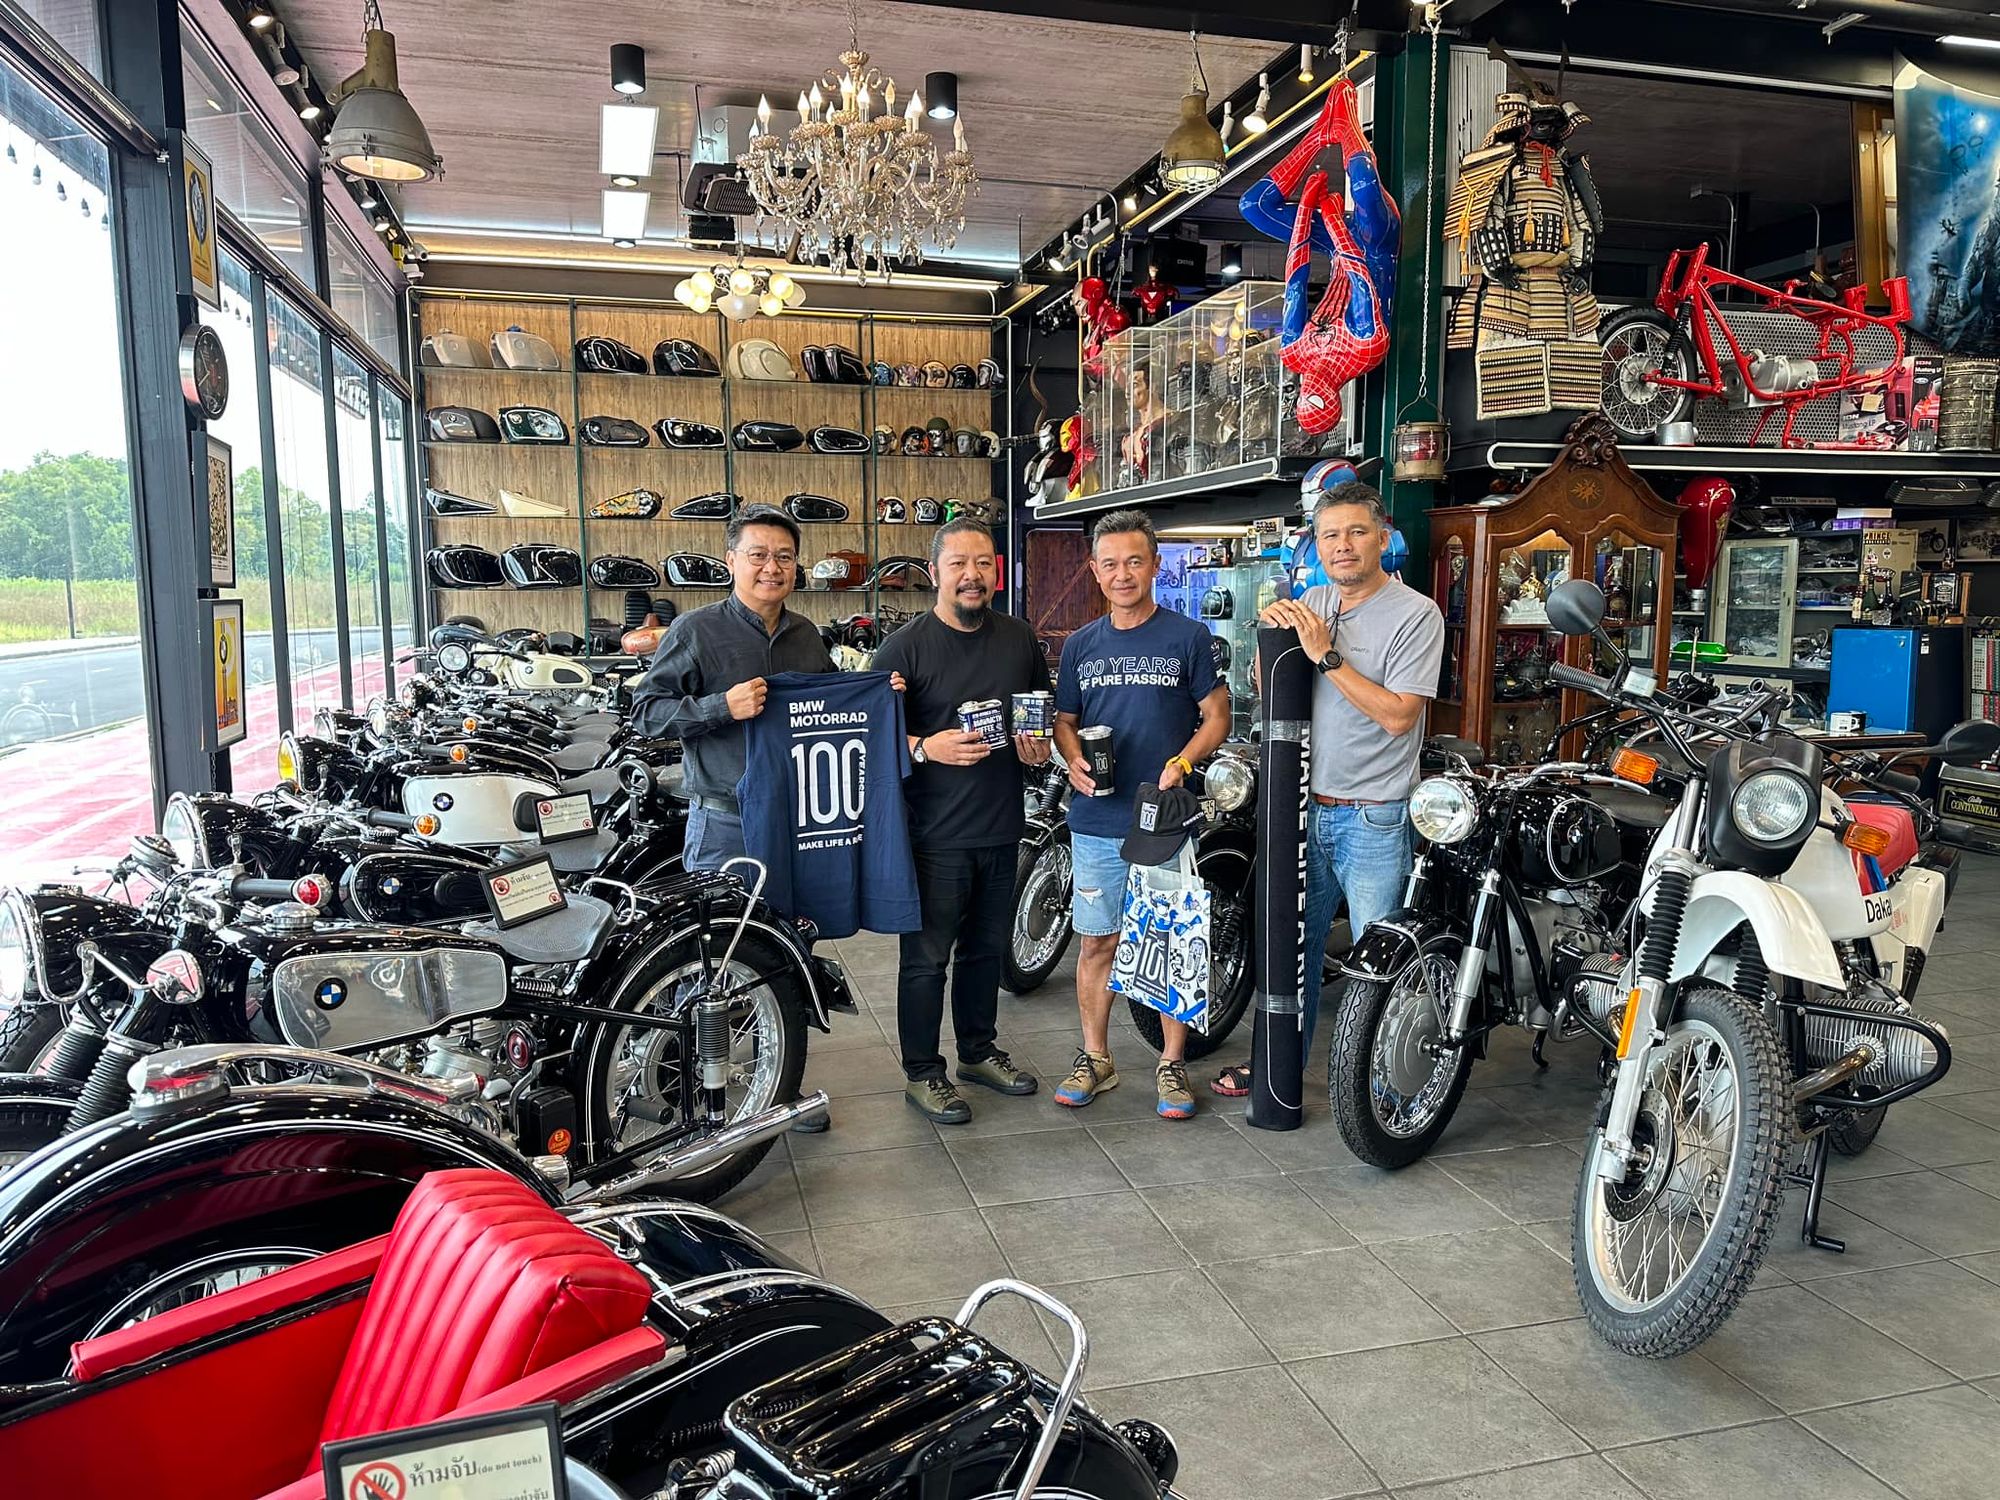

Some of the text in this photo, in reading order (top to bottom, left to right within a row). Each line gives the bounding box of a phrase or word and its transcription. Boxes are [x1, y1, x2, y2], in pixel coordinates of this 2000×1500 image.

[1109, 656, 1181, 676] YEARS
[1079, 673, 1179, 691] OF PURE PASSION
[789, 700, 825, 714] BMW
[790, 712, 868, 728] MOTORRAD
[1095, 757, 1109, 771] 100
[791, 738, 867, 827] 100
[1950, 800, 1999, 818] CONTINENTAL
[798, 838, 825, 851] MAKE
[825, 837, 844, 847] LIFE
[845, 837, 852, 846] A
[1865, 896, 1892, 923] Daka
[1172, 979, 1191, 990] 2023
[409, 1455, 477, 1487] ห้ามจับ
[496, 1461, 510, 1470] not
[513, 1455, 542, 1468] touch)
